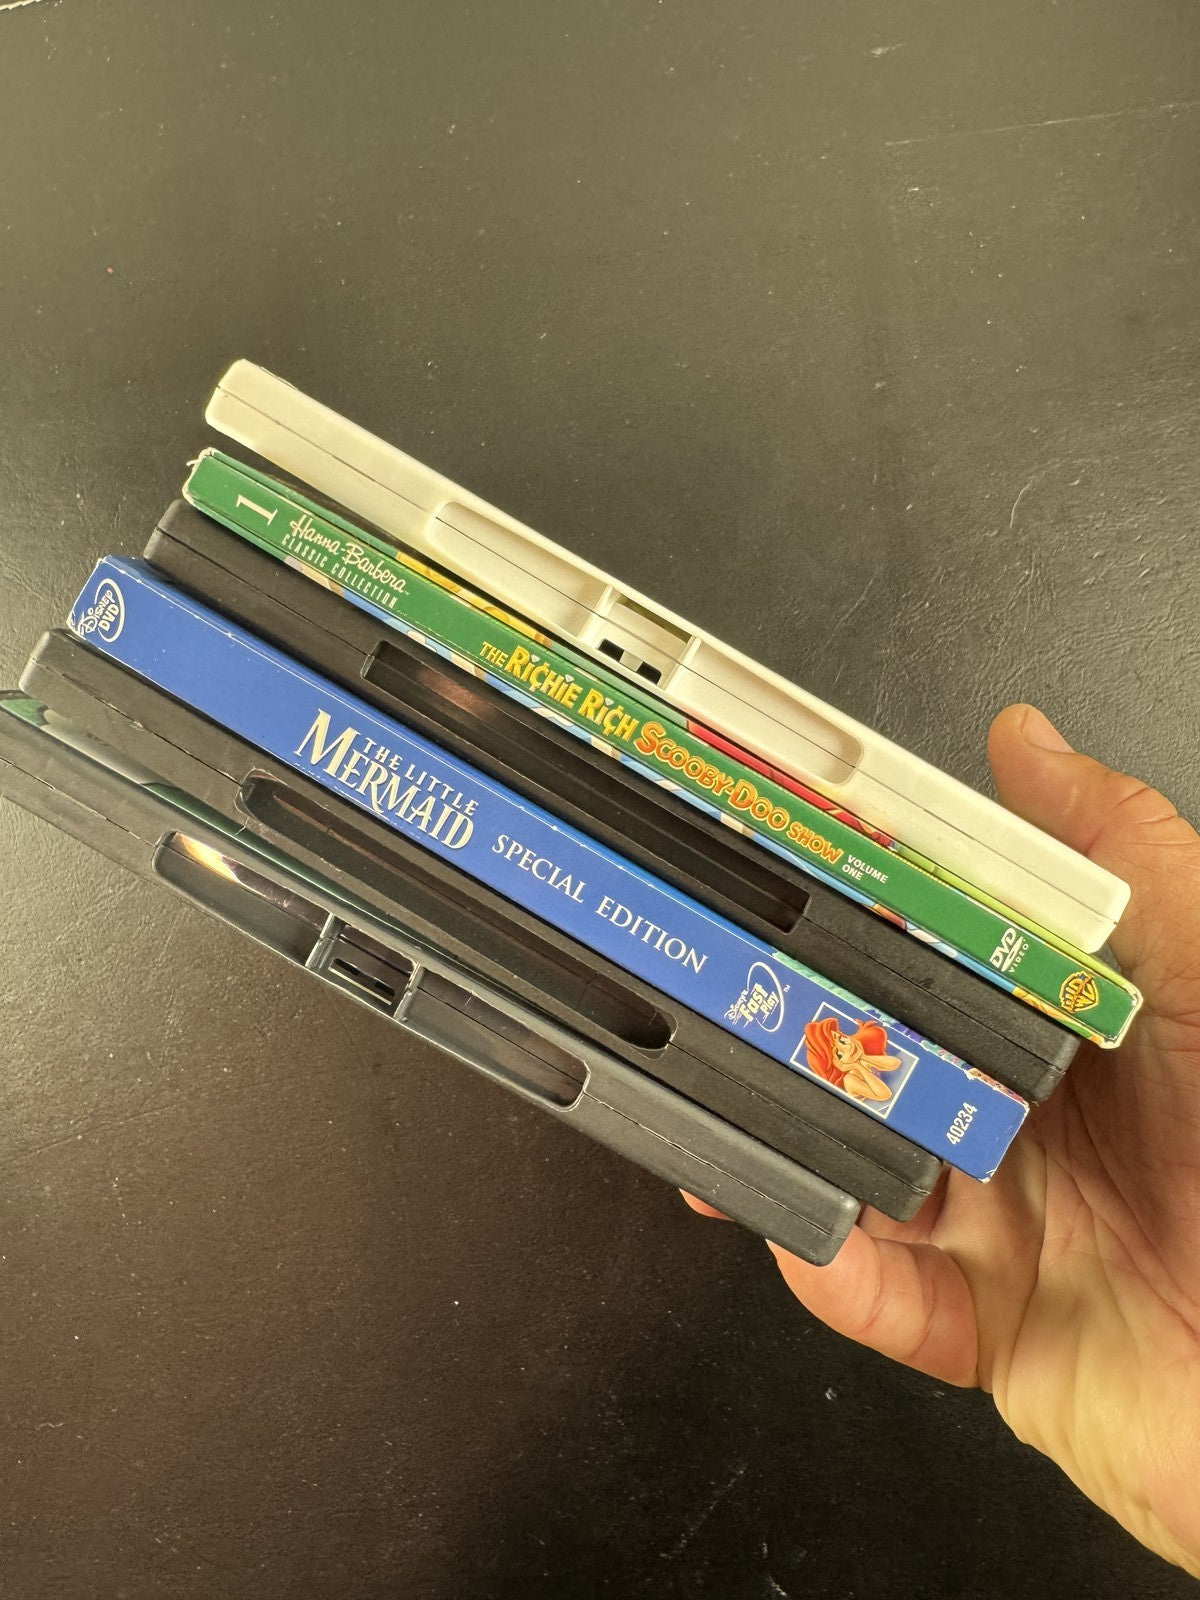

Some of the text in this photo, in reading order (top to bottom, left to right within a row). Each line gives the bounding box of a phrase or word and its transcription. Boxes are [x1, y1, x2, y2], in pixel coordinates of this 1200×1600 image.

[236, 494, 278, 525] 1
[281, 534, 398, 609] CLASSIC COLLECTION
[289, 514, 408, 594] Hanna-Barbera
[98, 603, 119, 632] DVD
[479, 641, 509, 668] THE
[786, 821, 843, 864] SHOW
[293, 708, 475, 849] MERMAID
[362, 737, 479, 816] THE LITTLE
[841, 863, 865, 881] ONE
[847, 854, 889, 884] VOLUME
[491, 834, 709, 974] SPECIAL EDITION
[989, 927, 1017, 969] DVD
[1009, 943, 1029, 973] VIDEO
[945, 1102, 978, 1146] 40234
